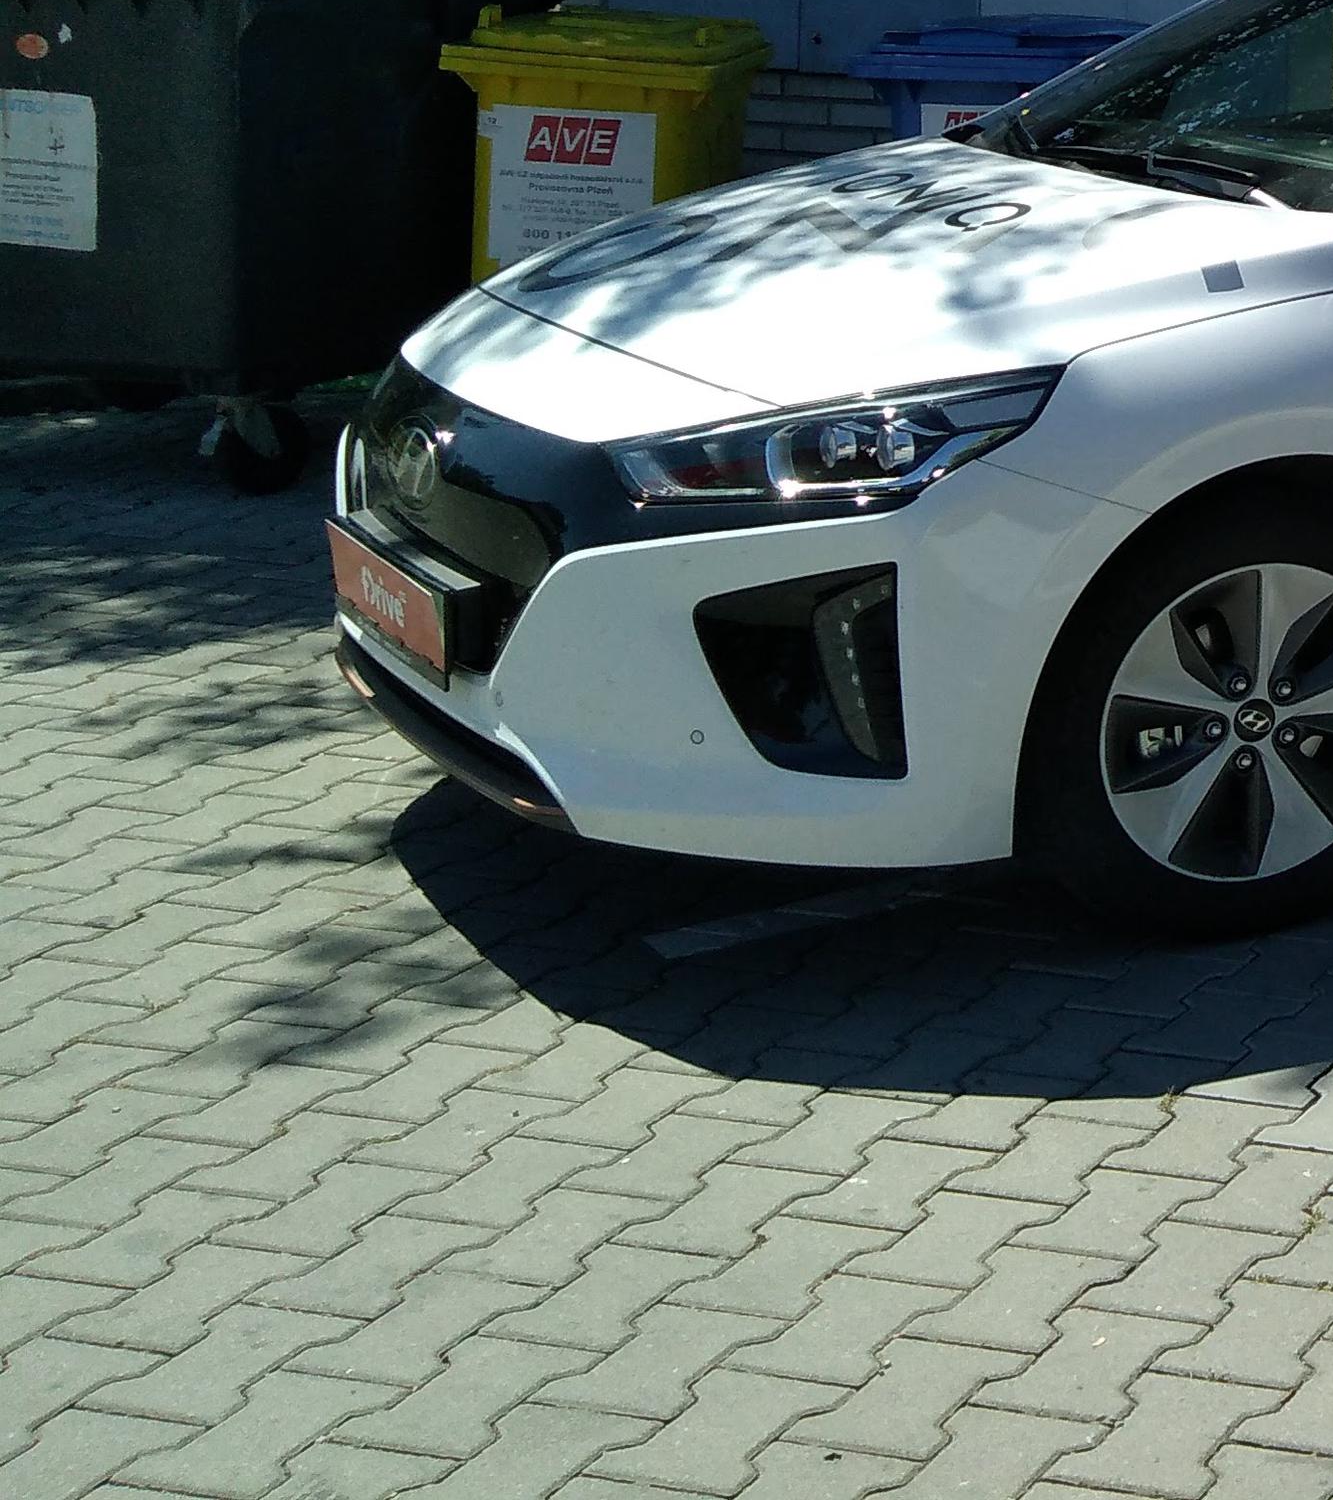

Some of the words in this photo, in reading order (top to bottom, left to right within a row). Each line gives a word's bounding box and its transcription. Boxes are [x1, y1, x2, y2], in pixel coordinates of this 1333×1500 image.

[528, 126, 615, 154] AVE
[587, 185, 614, 196] Plzeň
[806, 168, 1032, 233] IONIQ
